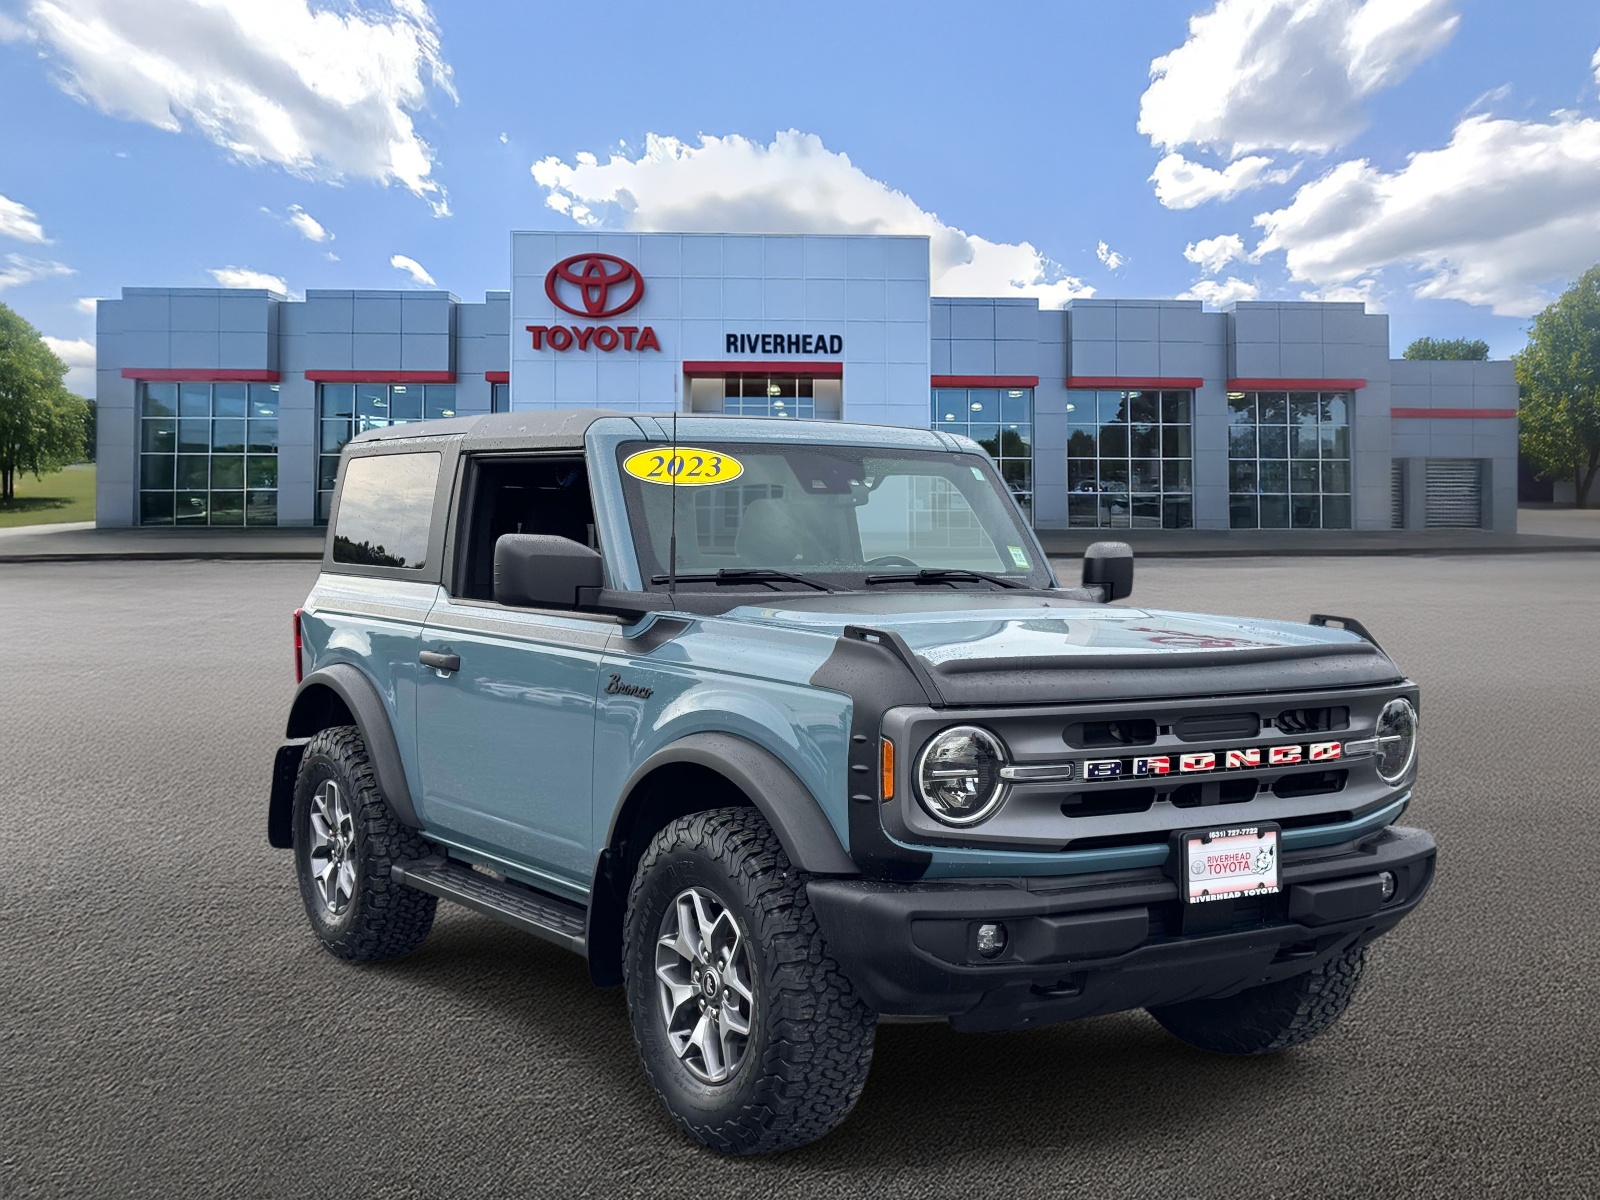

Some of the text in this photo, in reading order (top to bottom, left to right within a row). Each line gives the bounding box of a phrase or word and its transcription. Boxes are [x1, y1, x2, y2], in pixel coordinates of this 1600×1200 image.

[525, 325, 661, 352] TOYOTA
[725, 333, 843, 355] RIVERHEAD
[646, 455, 722, 477] 2023
[604, 672, 654, 699] Bronco
[1083, 741, 1341, 779] BRONCO
[1207, 852, 1251, 864] RIVERHEAD
[1208, 861, 1251, 875] TOYOTA
[1190, 886, 1279, 904] RIVERHEAD TOYOTA
